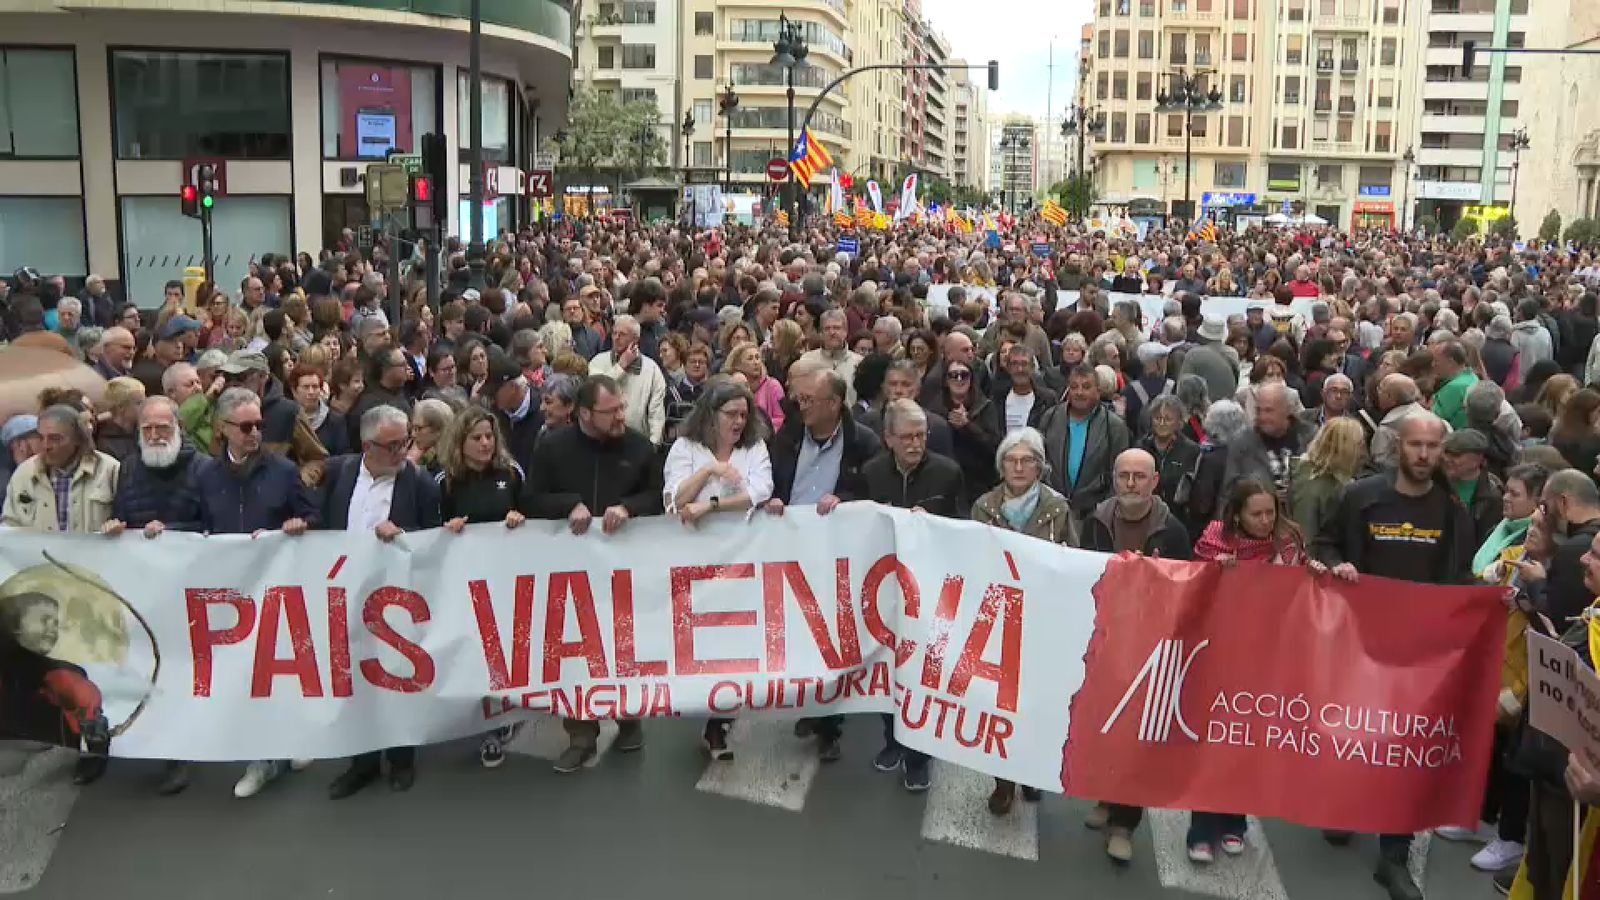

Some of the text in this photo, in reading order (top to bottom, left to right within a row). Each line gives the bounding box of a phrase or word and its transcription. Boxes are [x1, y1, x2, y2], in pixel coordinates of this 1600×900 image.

[185, 550, 1024, 713] PAÍS VALENCIÀ
[1539, 648, 1561, 675] La
[707, 661, 892, 714] CULTURA
[1539, 679, 1562, 701] no
[1207, 719, 1256, 746] DEL
[1265, 725, 1321, 757] PAÍS
[1209, 691, 1461, 741] ACCIÓ CULTURAL
